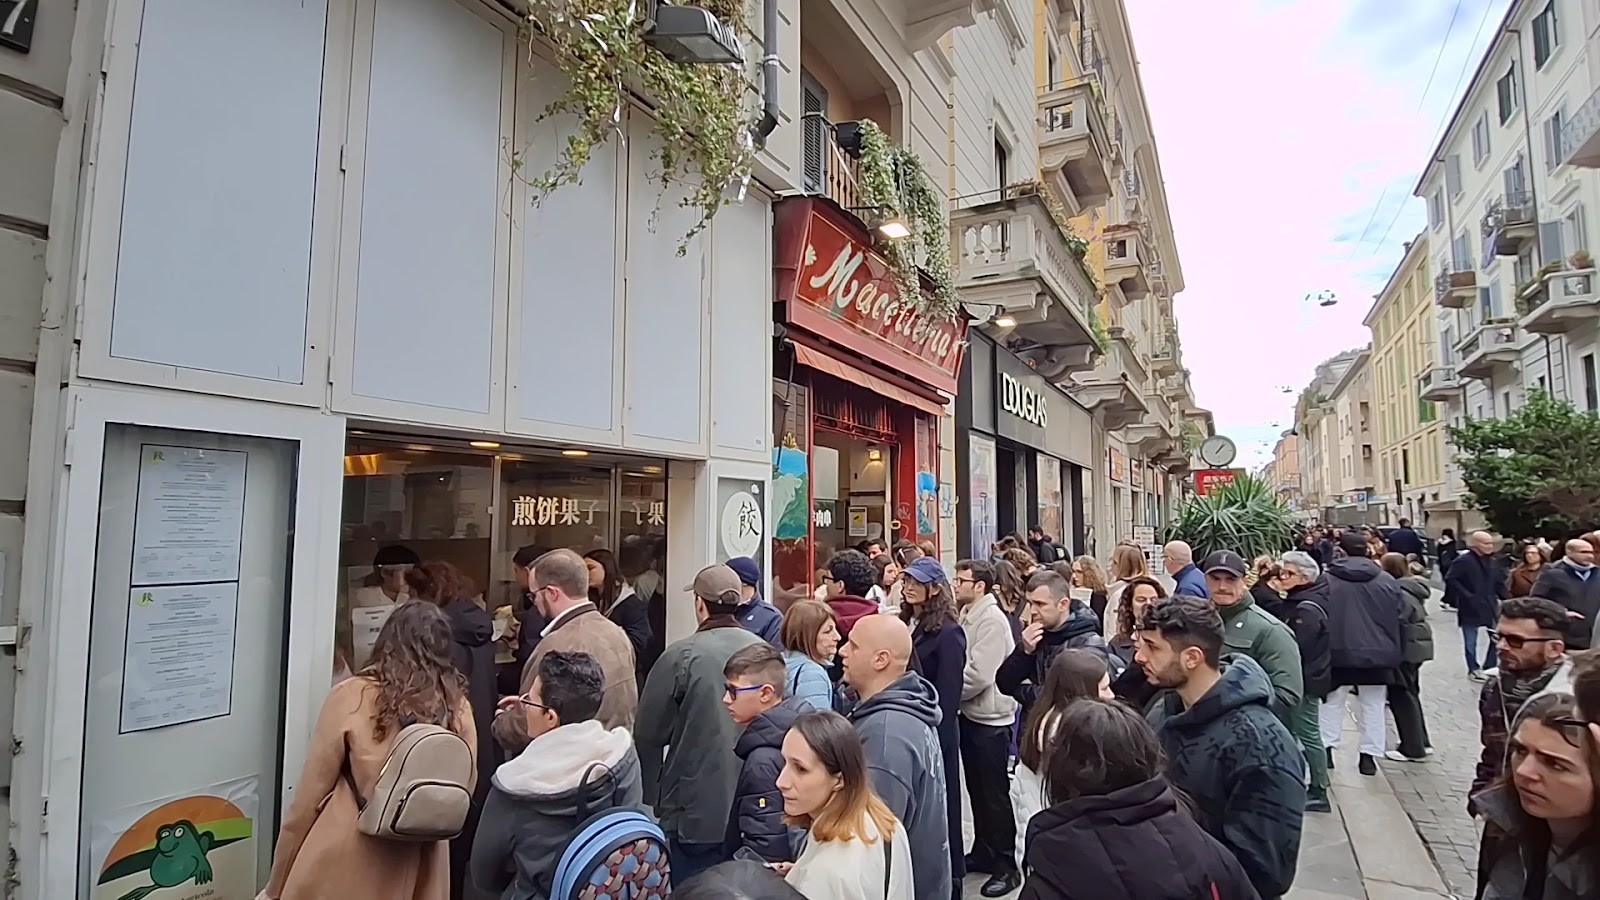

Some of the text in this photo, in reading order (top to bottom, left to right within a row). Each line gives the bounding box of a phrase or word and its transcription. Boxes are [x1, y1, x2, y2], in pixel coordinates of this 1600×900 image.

[1002, 371, 1047, 428] DOUGLAS
[511, 495, 601, 526] 煎饼果子
[181, 888, 215, 900] gricola
